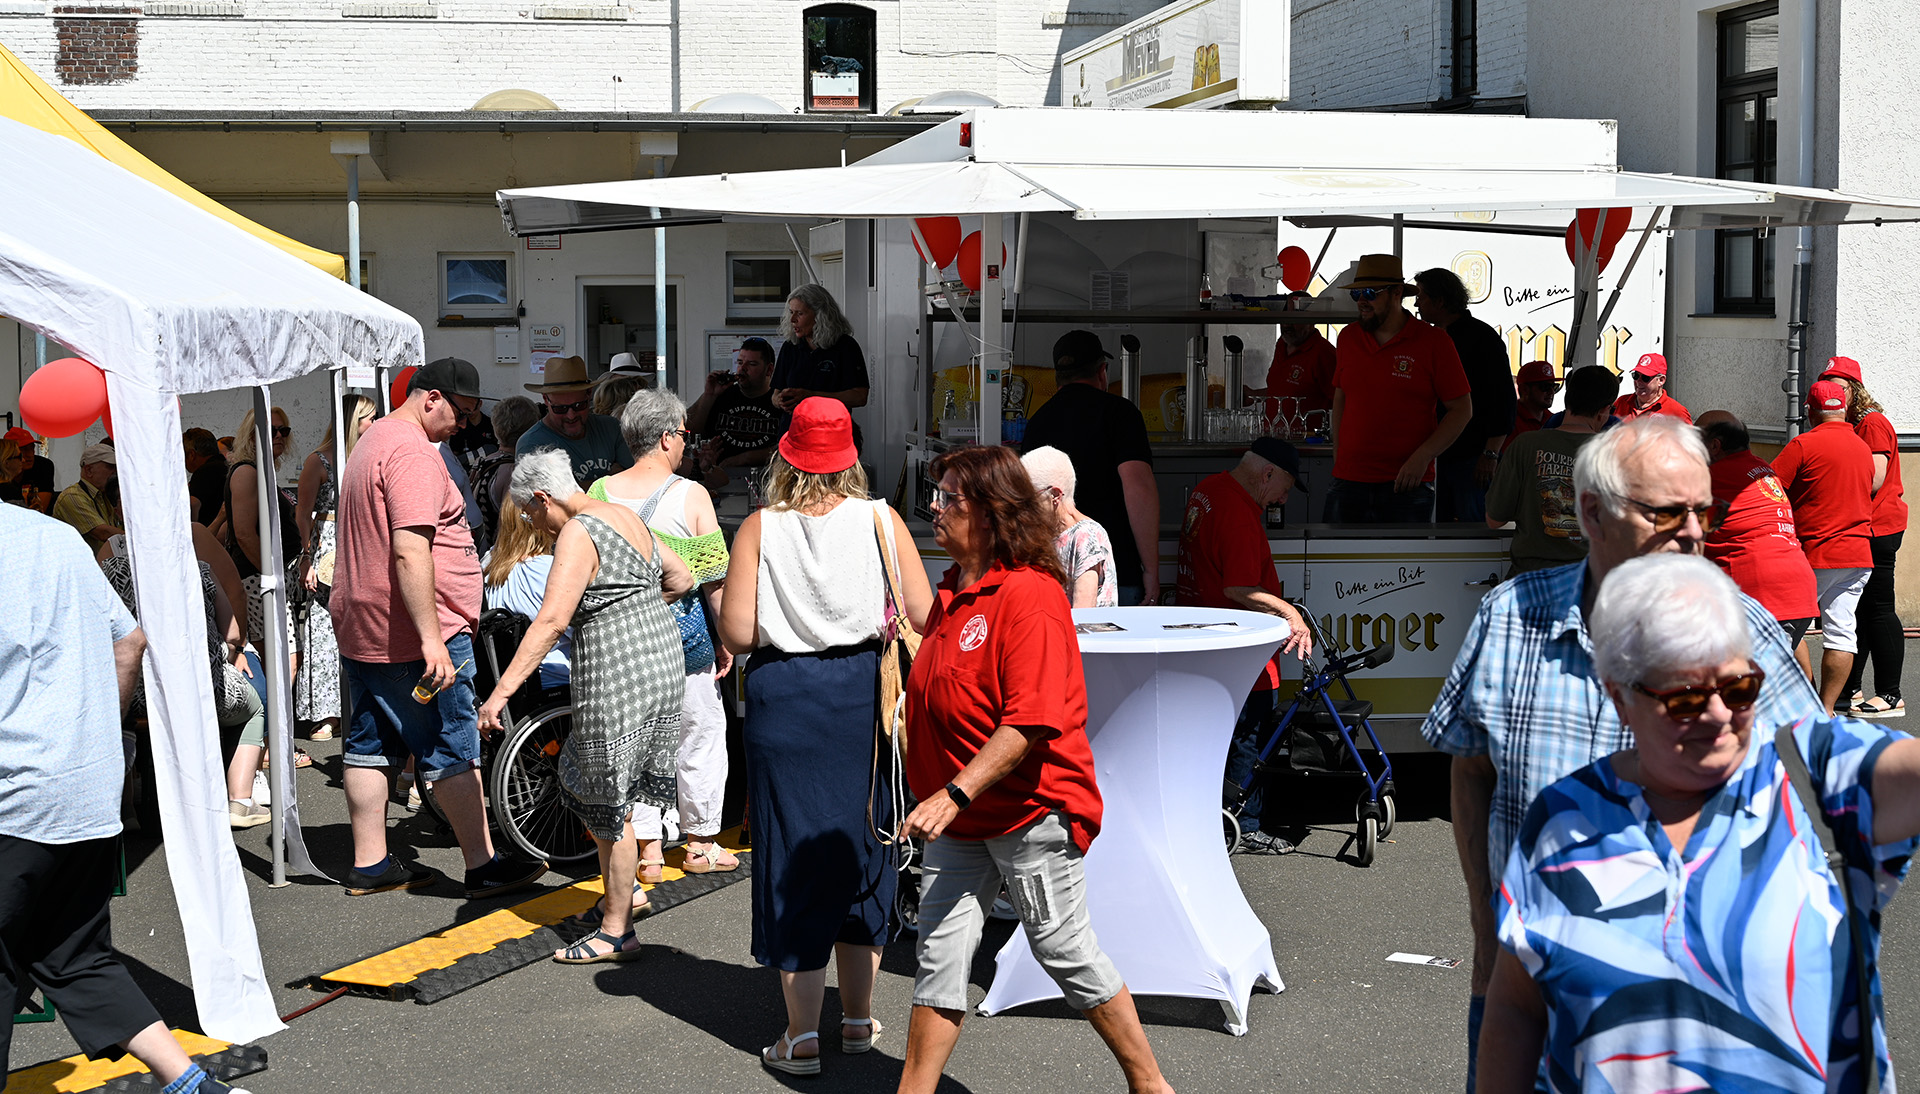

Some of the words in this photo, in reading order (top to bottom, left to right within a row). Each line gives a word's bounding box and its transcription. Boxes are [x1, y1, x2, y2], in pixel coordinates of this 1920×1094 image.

[1122, 32, 1161, 83] MEYER
[1503, 286, 1540, 308] Bitte
[1546, 284, 1571, 299] ein
[728, 406, 771, 419] SUPERIOR
[721, 430, 770, 448] STANDARD
[1777, 507, 1784, 518] 6
[1335, 581, 1368, 600] Bitte
[1373, 579, 1395, 591] ein
[1398, 566, 1426, 584] Bit
